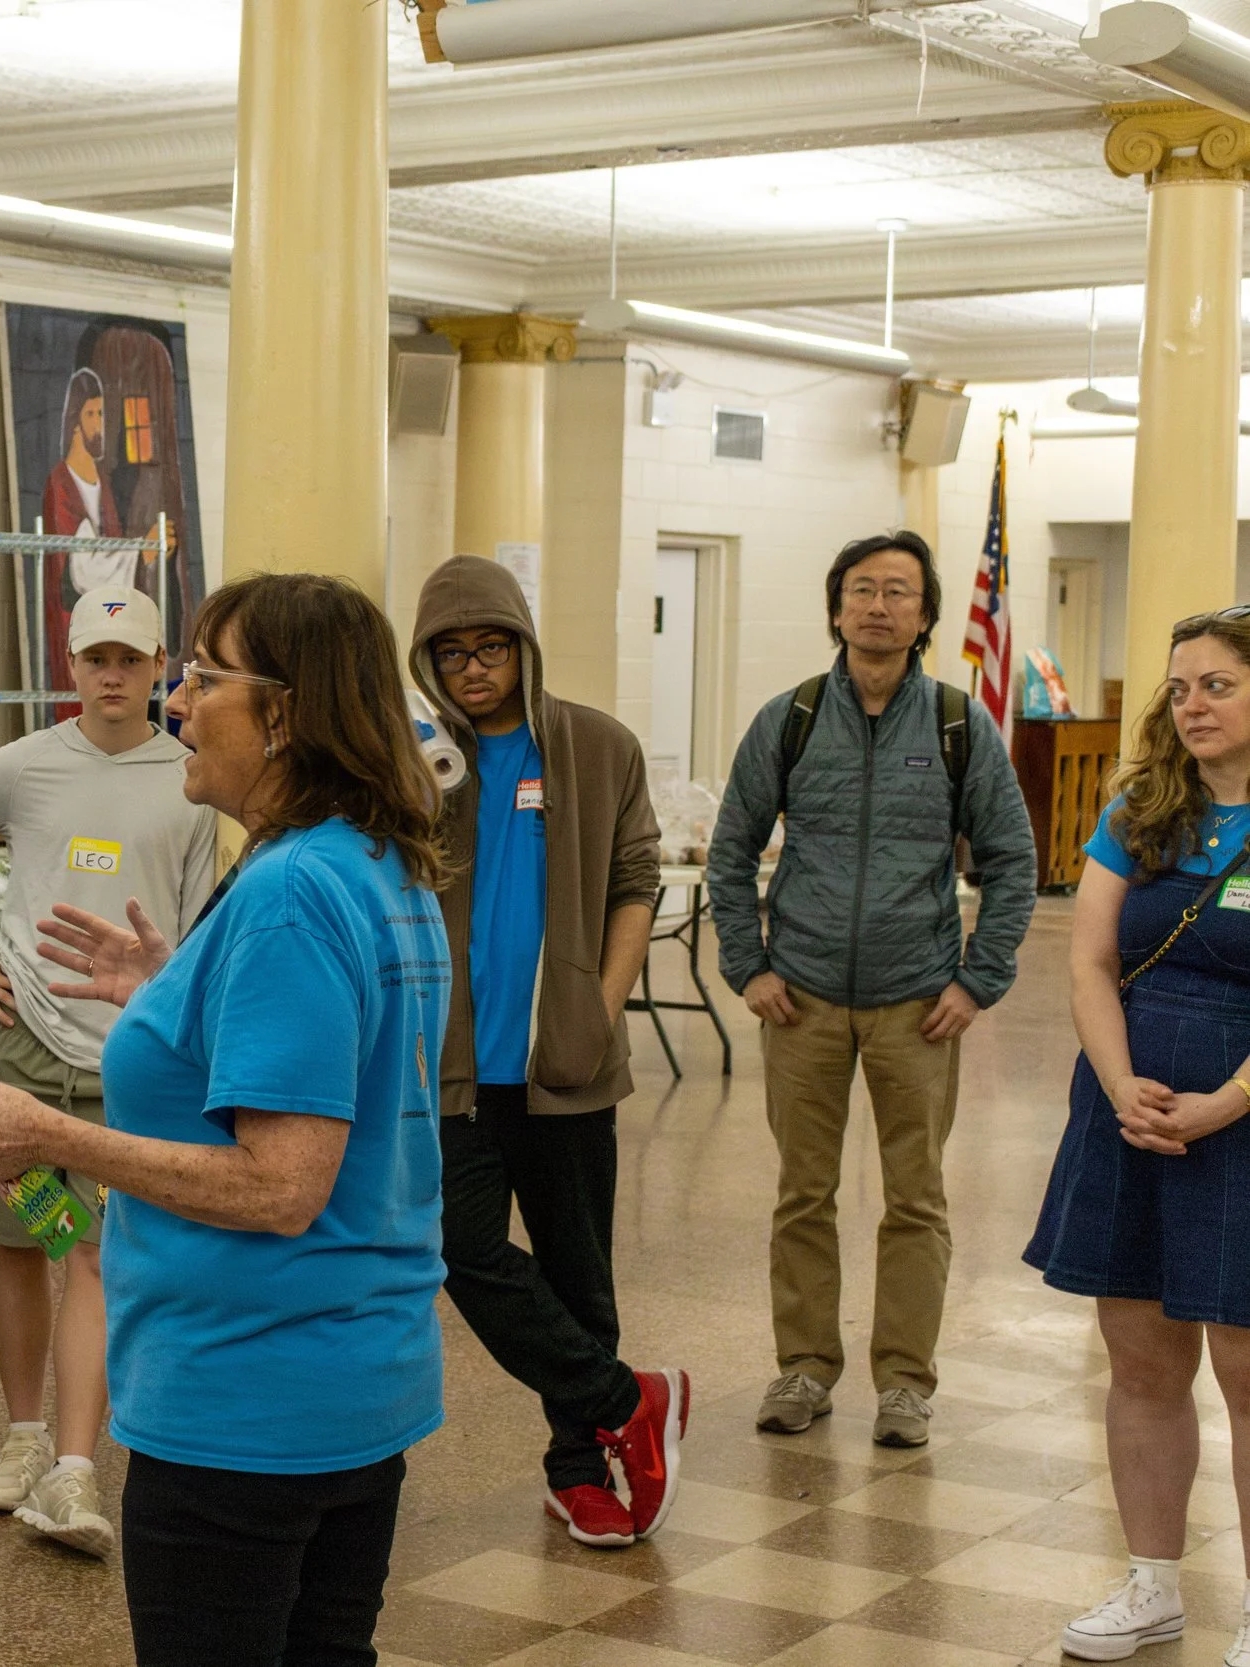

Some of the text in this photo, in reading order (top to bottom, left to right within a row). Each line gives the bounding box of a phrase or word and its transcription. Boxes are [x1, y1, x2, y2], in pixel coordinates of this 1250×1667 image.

[517, 781, 541, 790] Hello
[76, 851, 114, 870] LEO
[24, 1184, 51, 1214] 2024
